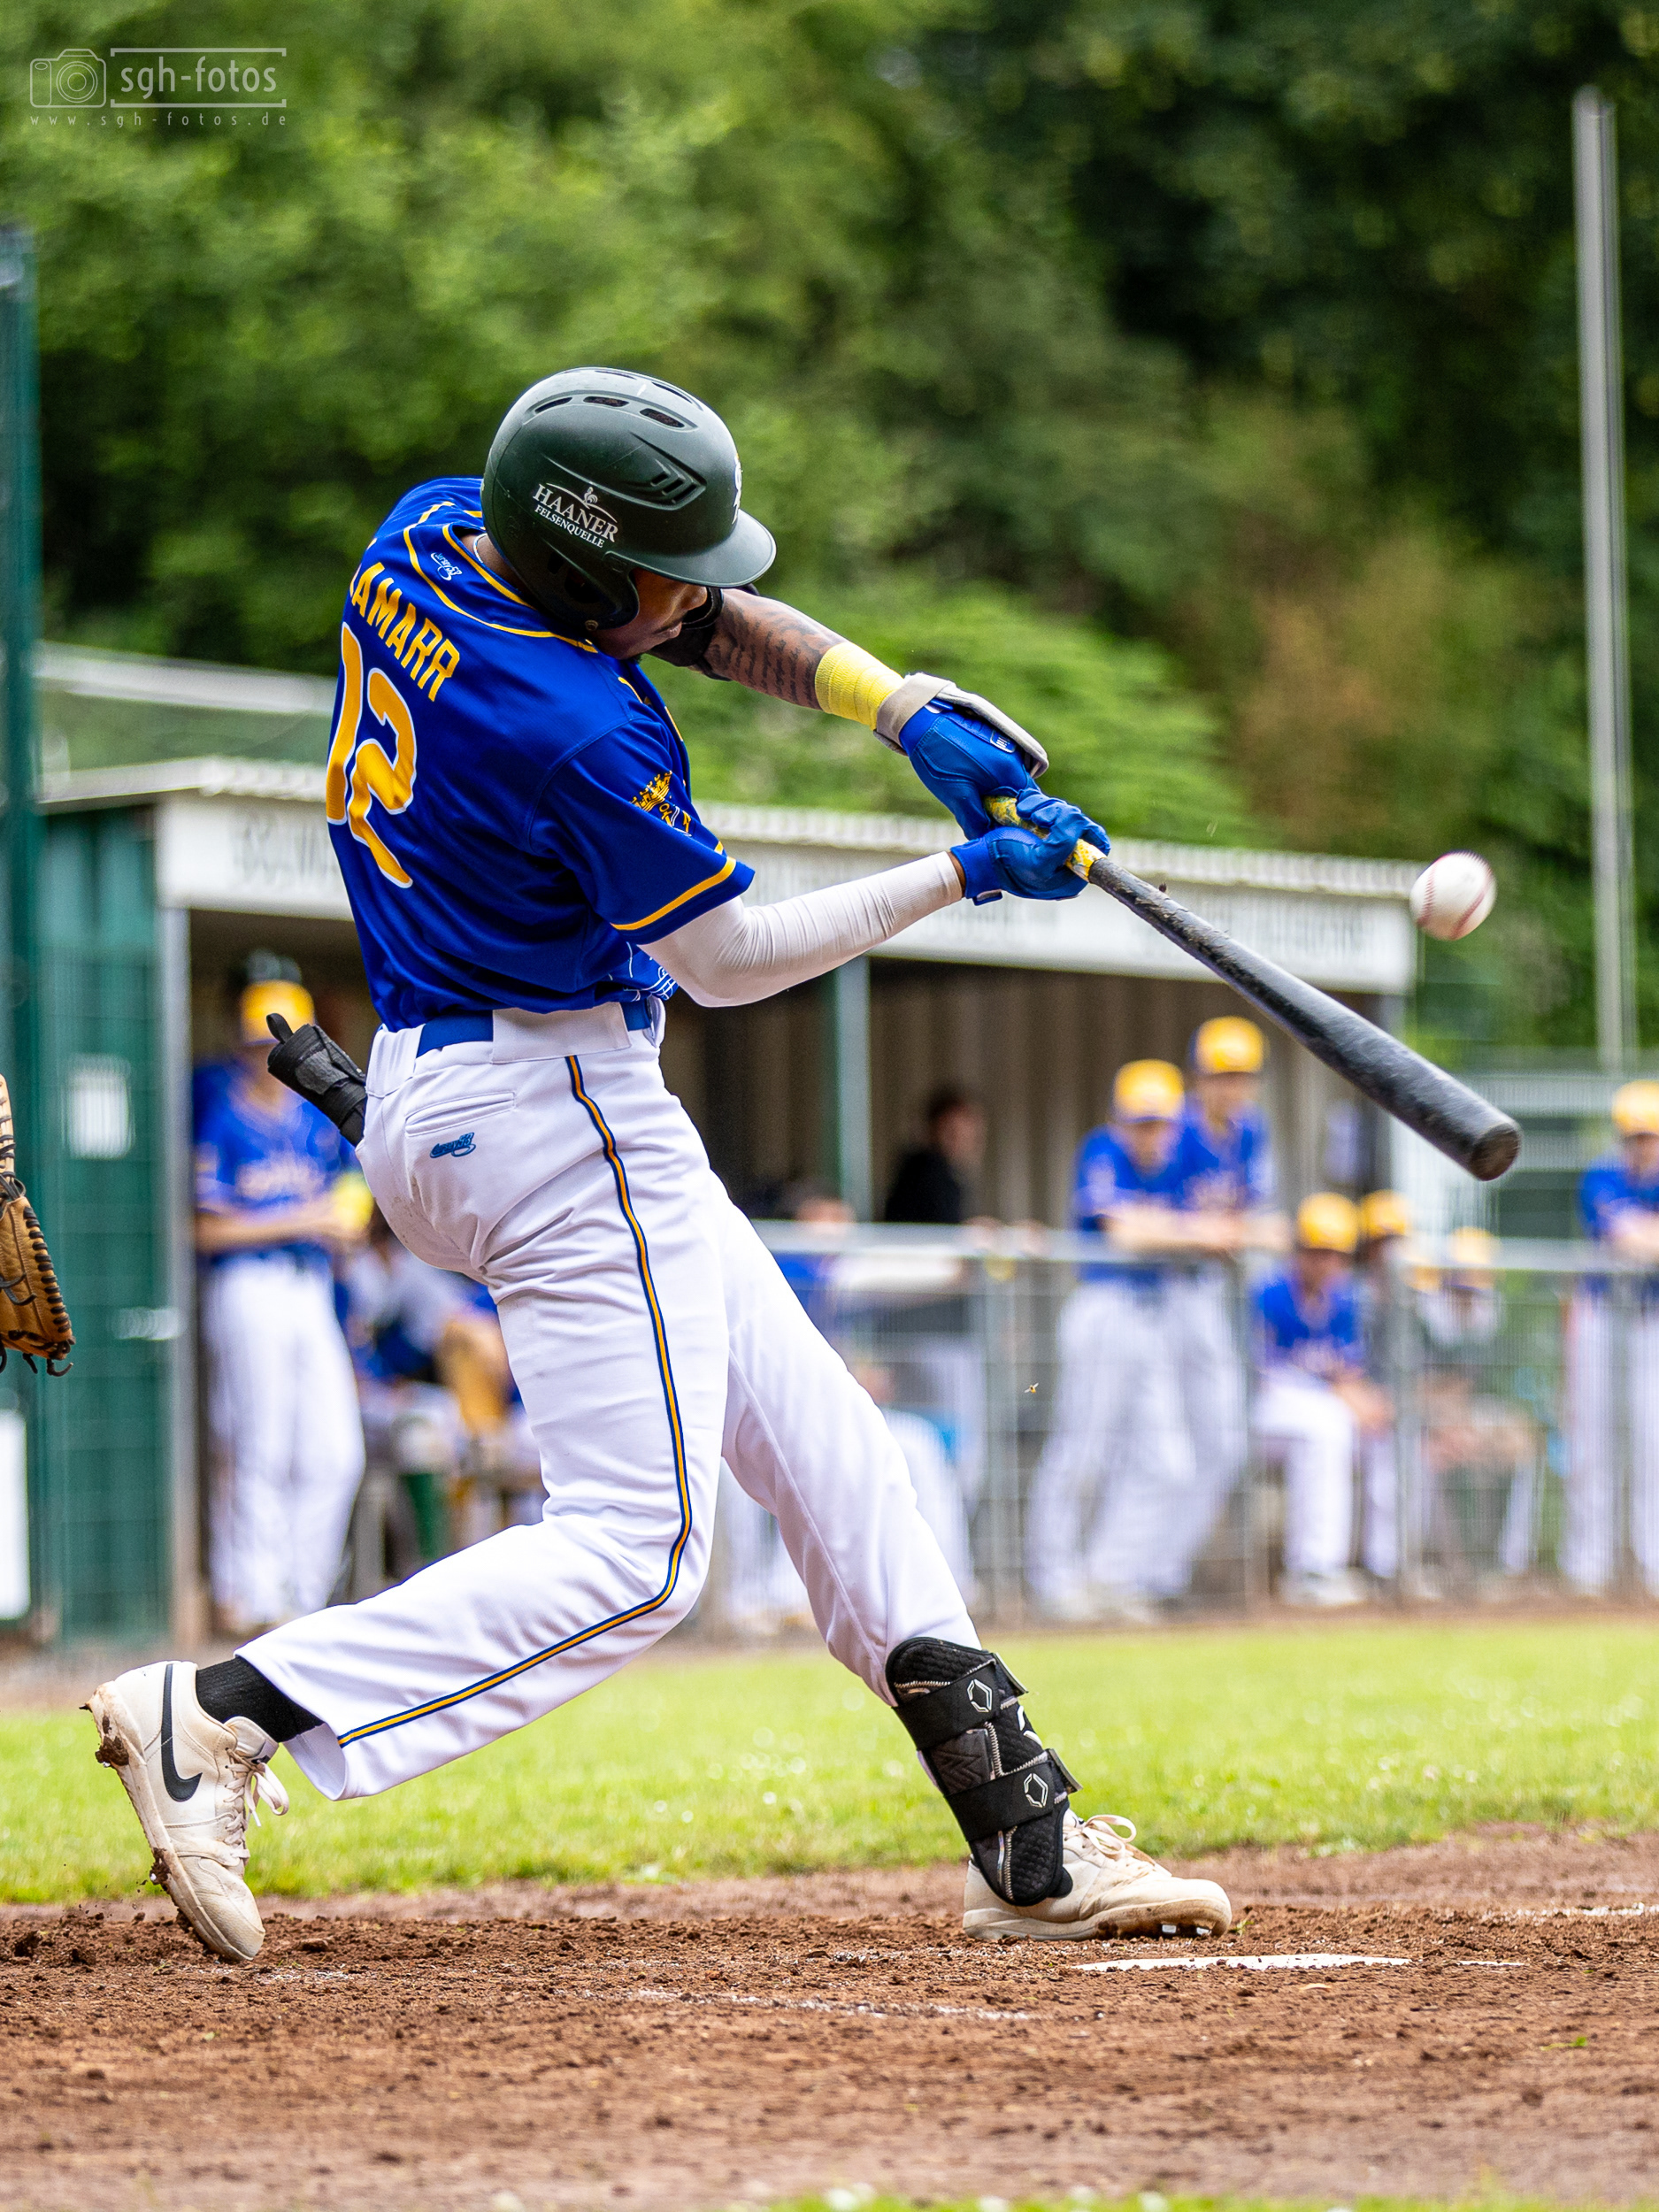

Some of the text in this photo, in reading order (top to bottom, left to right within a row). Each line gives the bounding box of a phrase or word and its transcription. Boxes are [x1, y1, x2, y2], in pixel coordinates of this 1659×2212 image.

[533, 483, 618, 542] HAANER
[534, 504, 605, 548] FELSENQUELLE
[349, 561, 460, 702] AMARR
